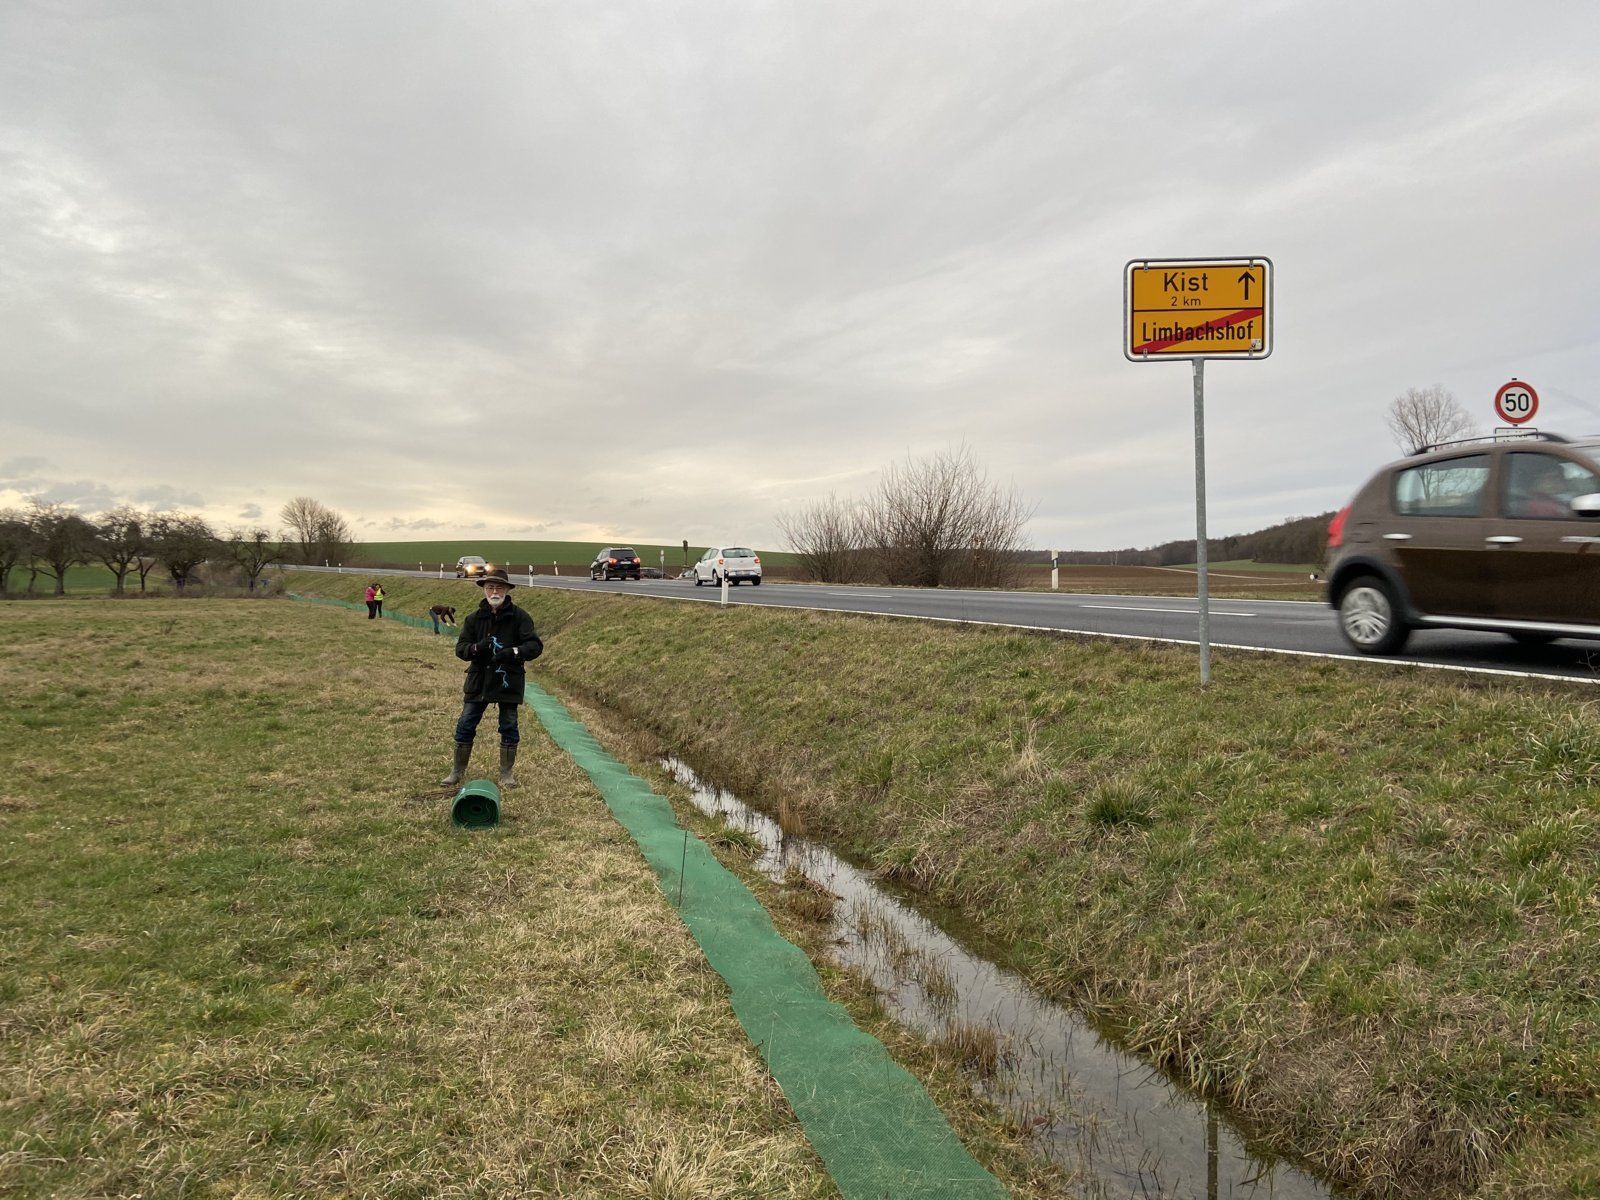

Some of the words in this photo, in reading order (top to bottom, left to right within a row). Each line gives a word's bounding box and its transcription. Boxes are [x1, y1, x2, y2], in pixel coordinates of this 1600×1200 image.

[1163, 272, 1209, 292] Kist
[1171, 296, 1178, 307] 2
[1183, 295, 1201, 306] km
[1142, 320, 1254, 342] Limbachshof
[1505, 393, 1529, 412] 50
